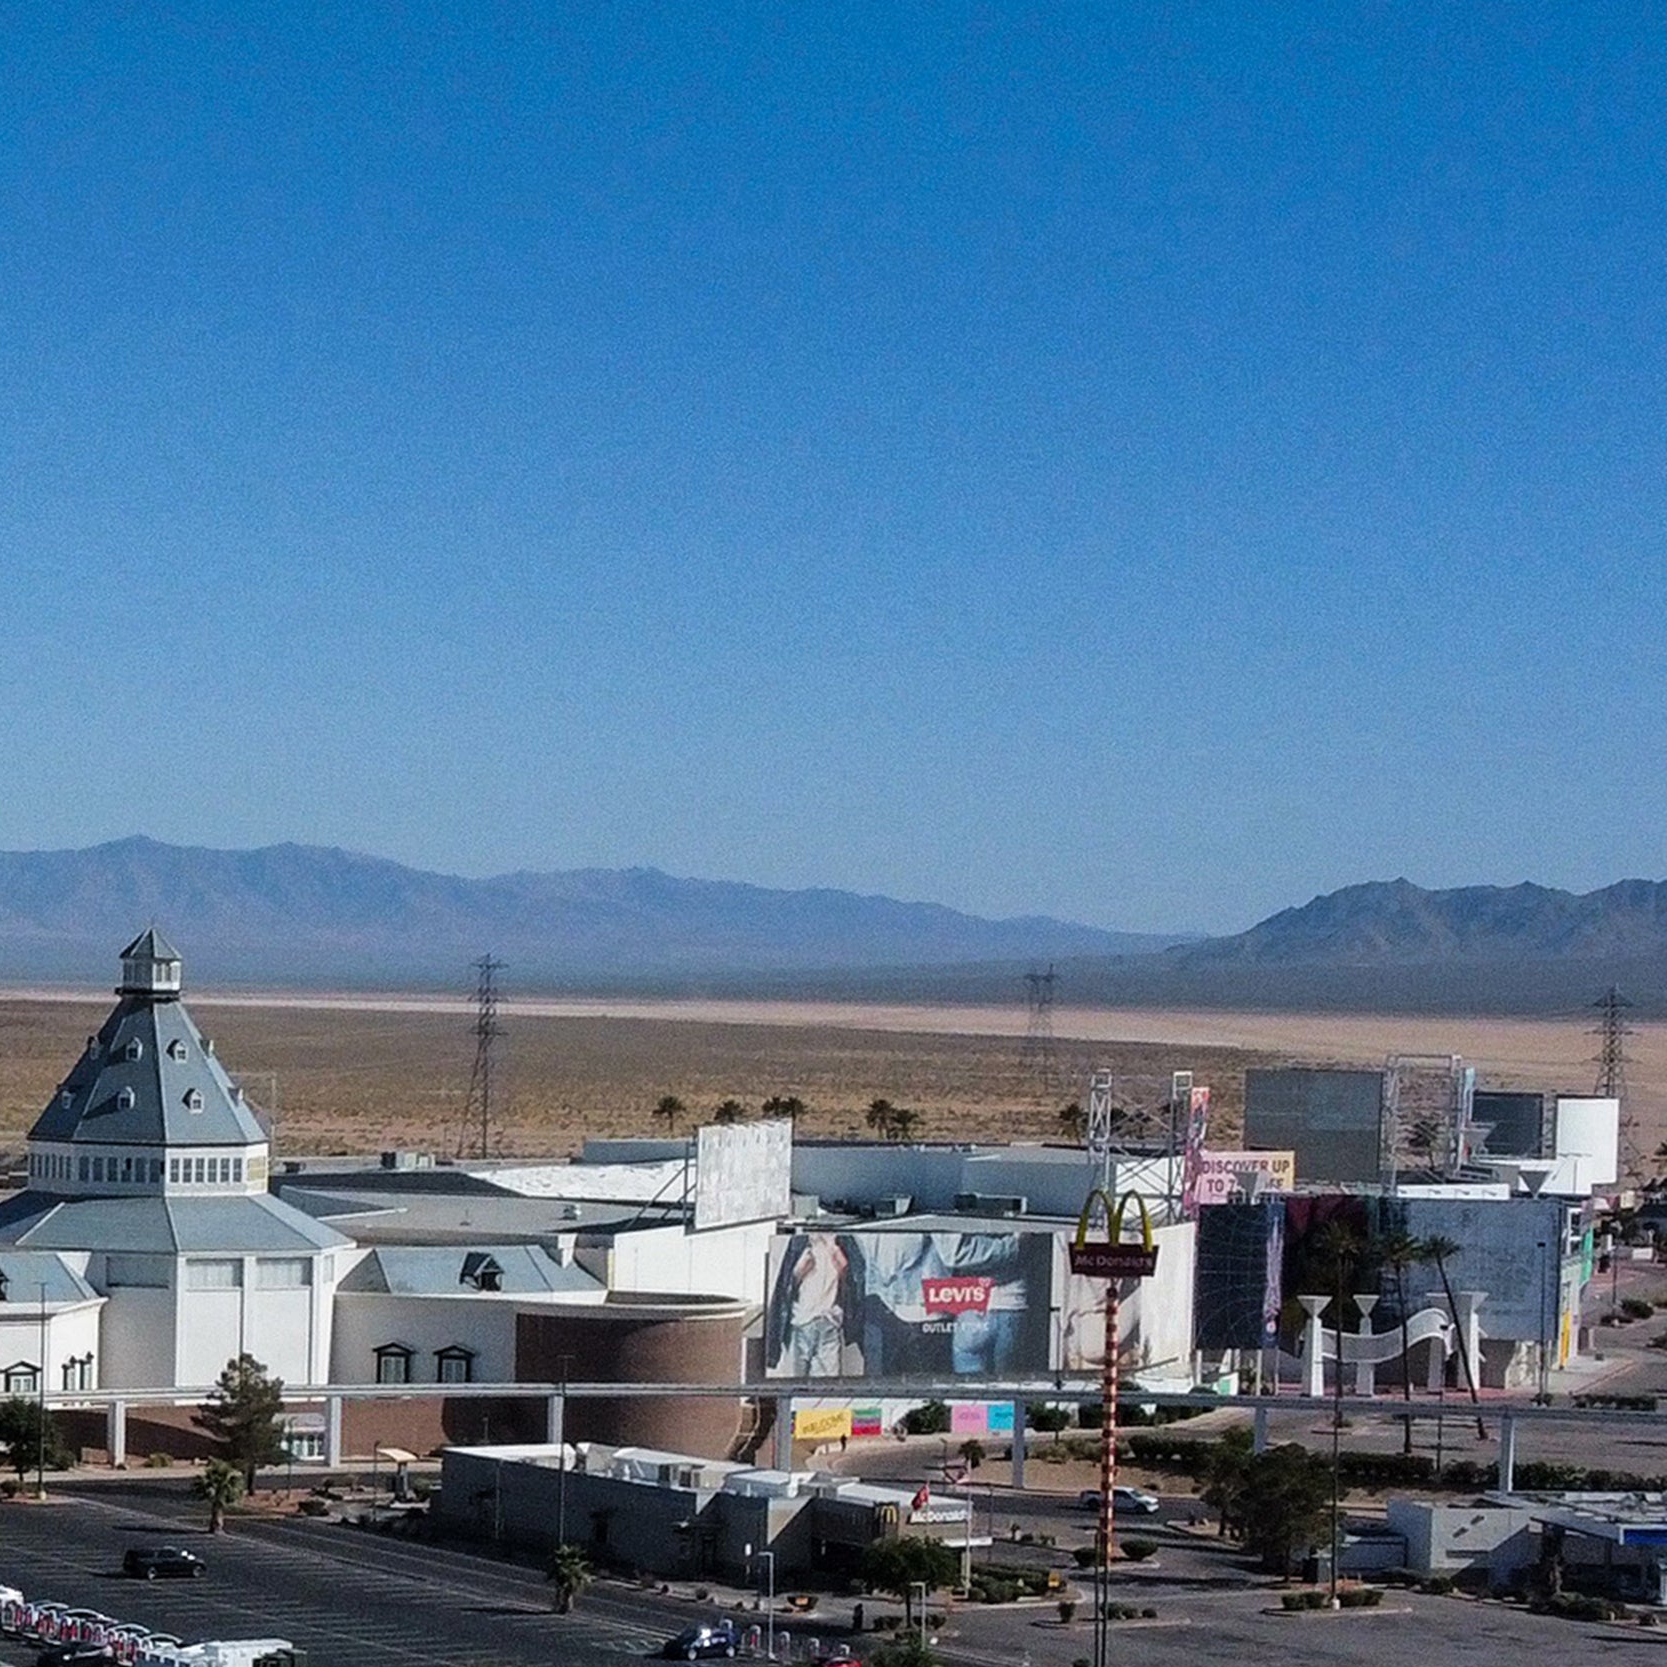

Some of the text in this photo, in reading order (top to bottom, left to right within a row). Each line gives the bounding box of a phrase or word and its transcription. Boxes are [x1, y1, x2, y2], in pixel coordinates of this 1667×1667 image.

[1202, 1160, 1290, 1174] DISCOVER UP
[1207, 1179, 1224, 1192] TO
